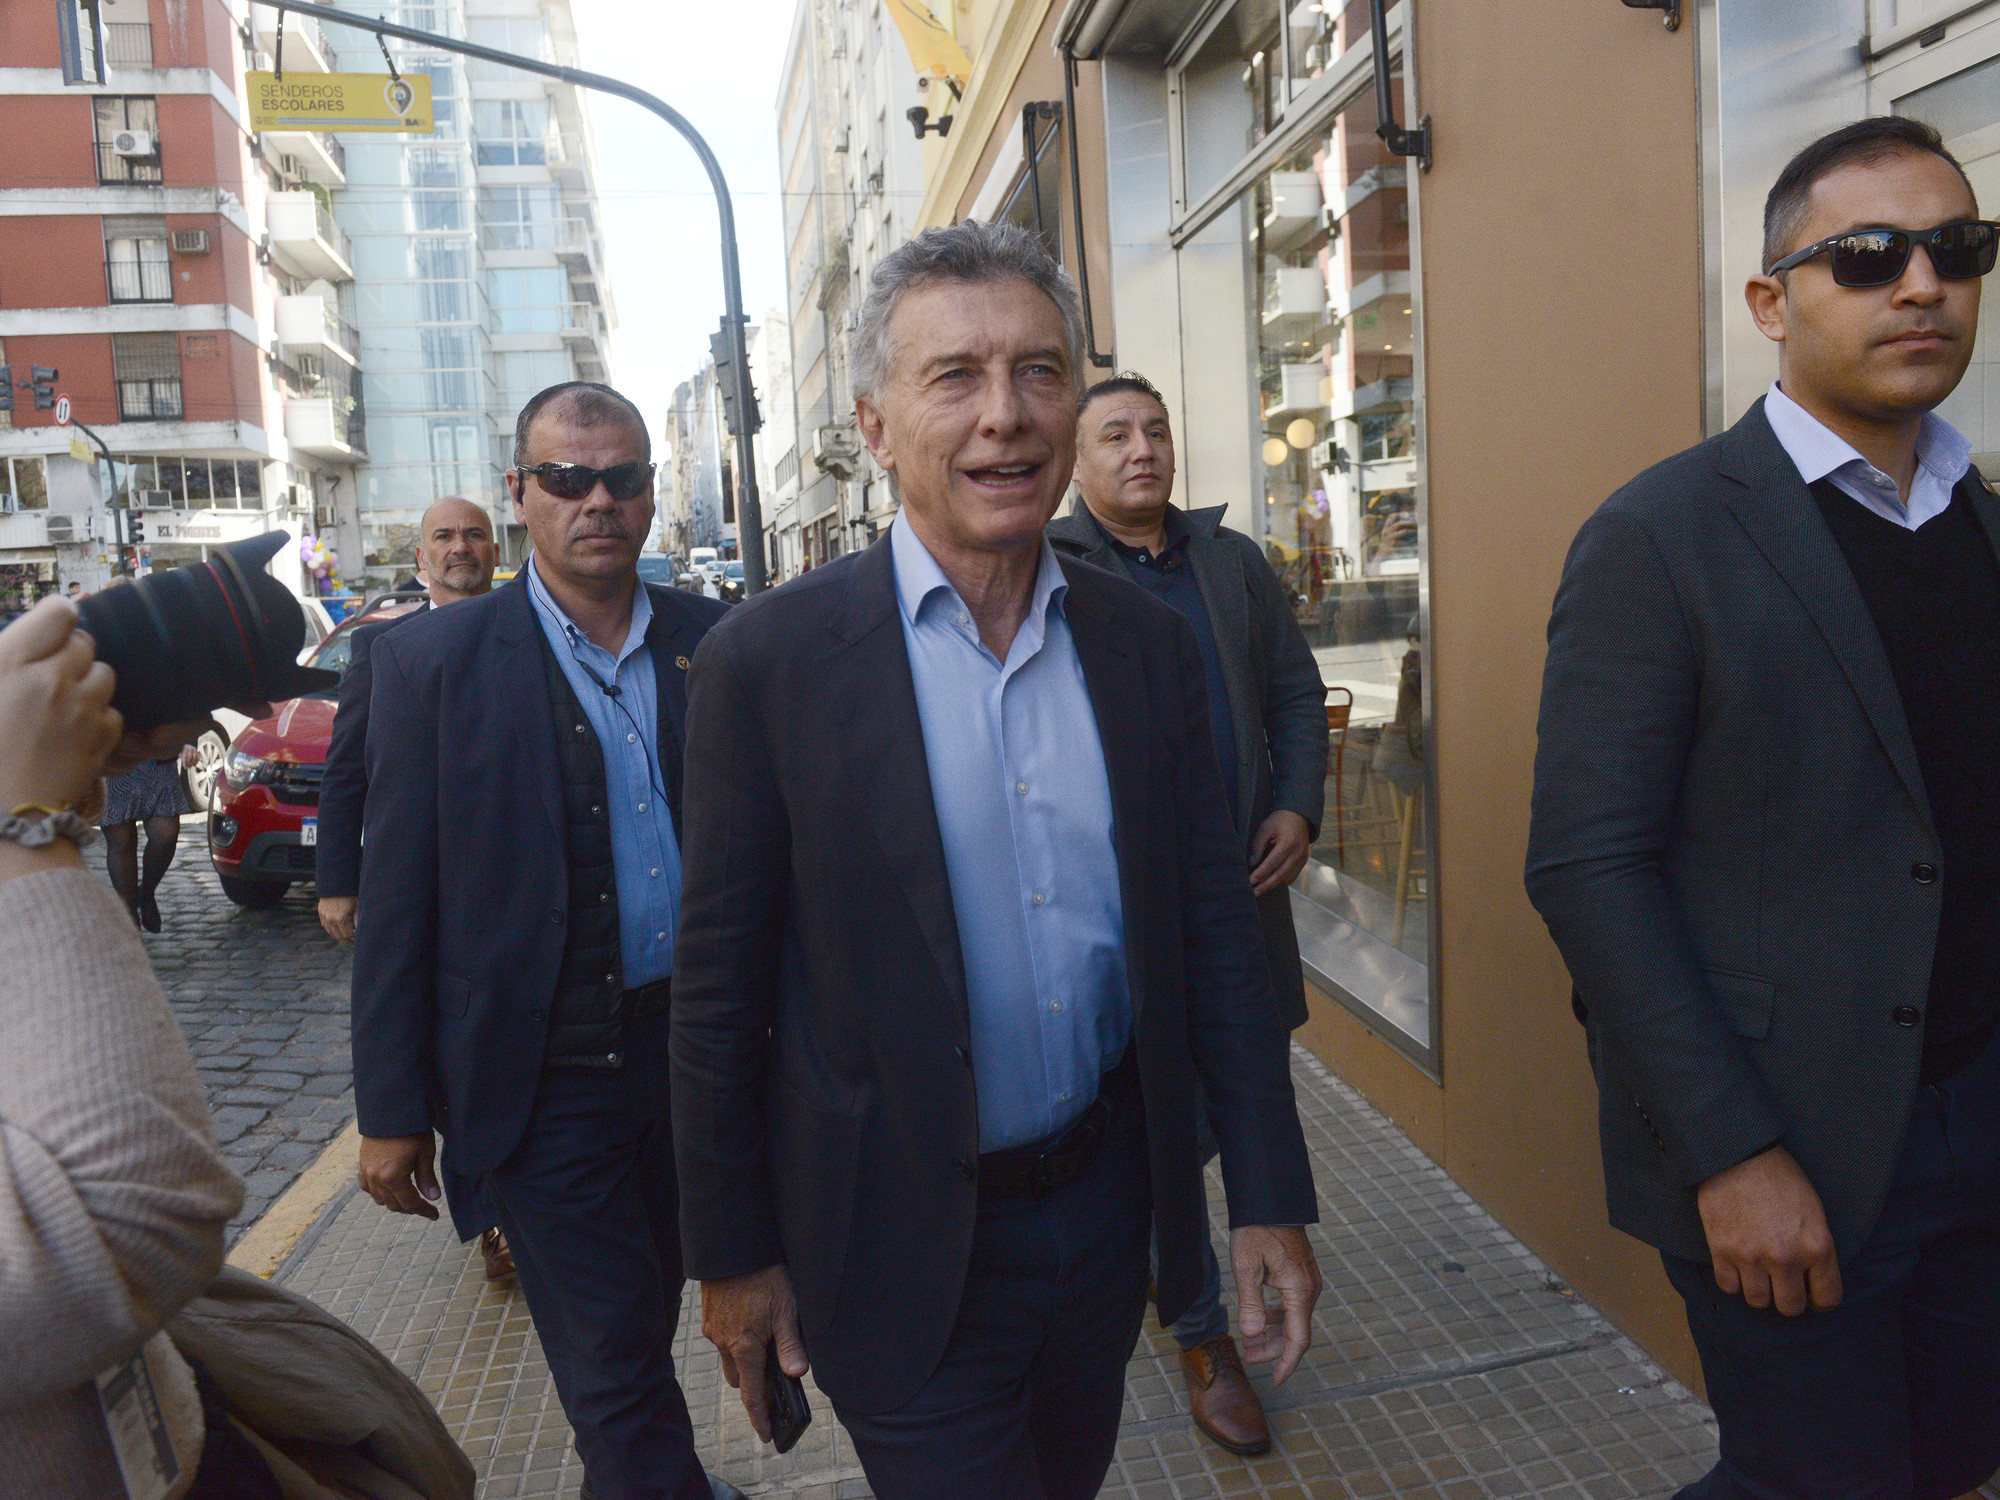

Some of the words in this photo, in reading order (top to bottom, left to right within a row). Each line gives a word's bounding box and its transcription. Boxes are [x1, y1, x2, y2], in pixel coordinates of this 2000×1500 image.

[260, 84, 344, 98] SENDEROS
[262, 99, 345, 111] ESCOLARES
[157, 525, 173, 537] EL
